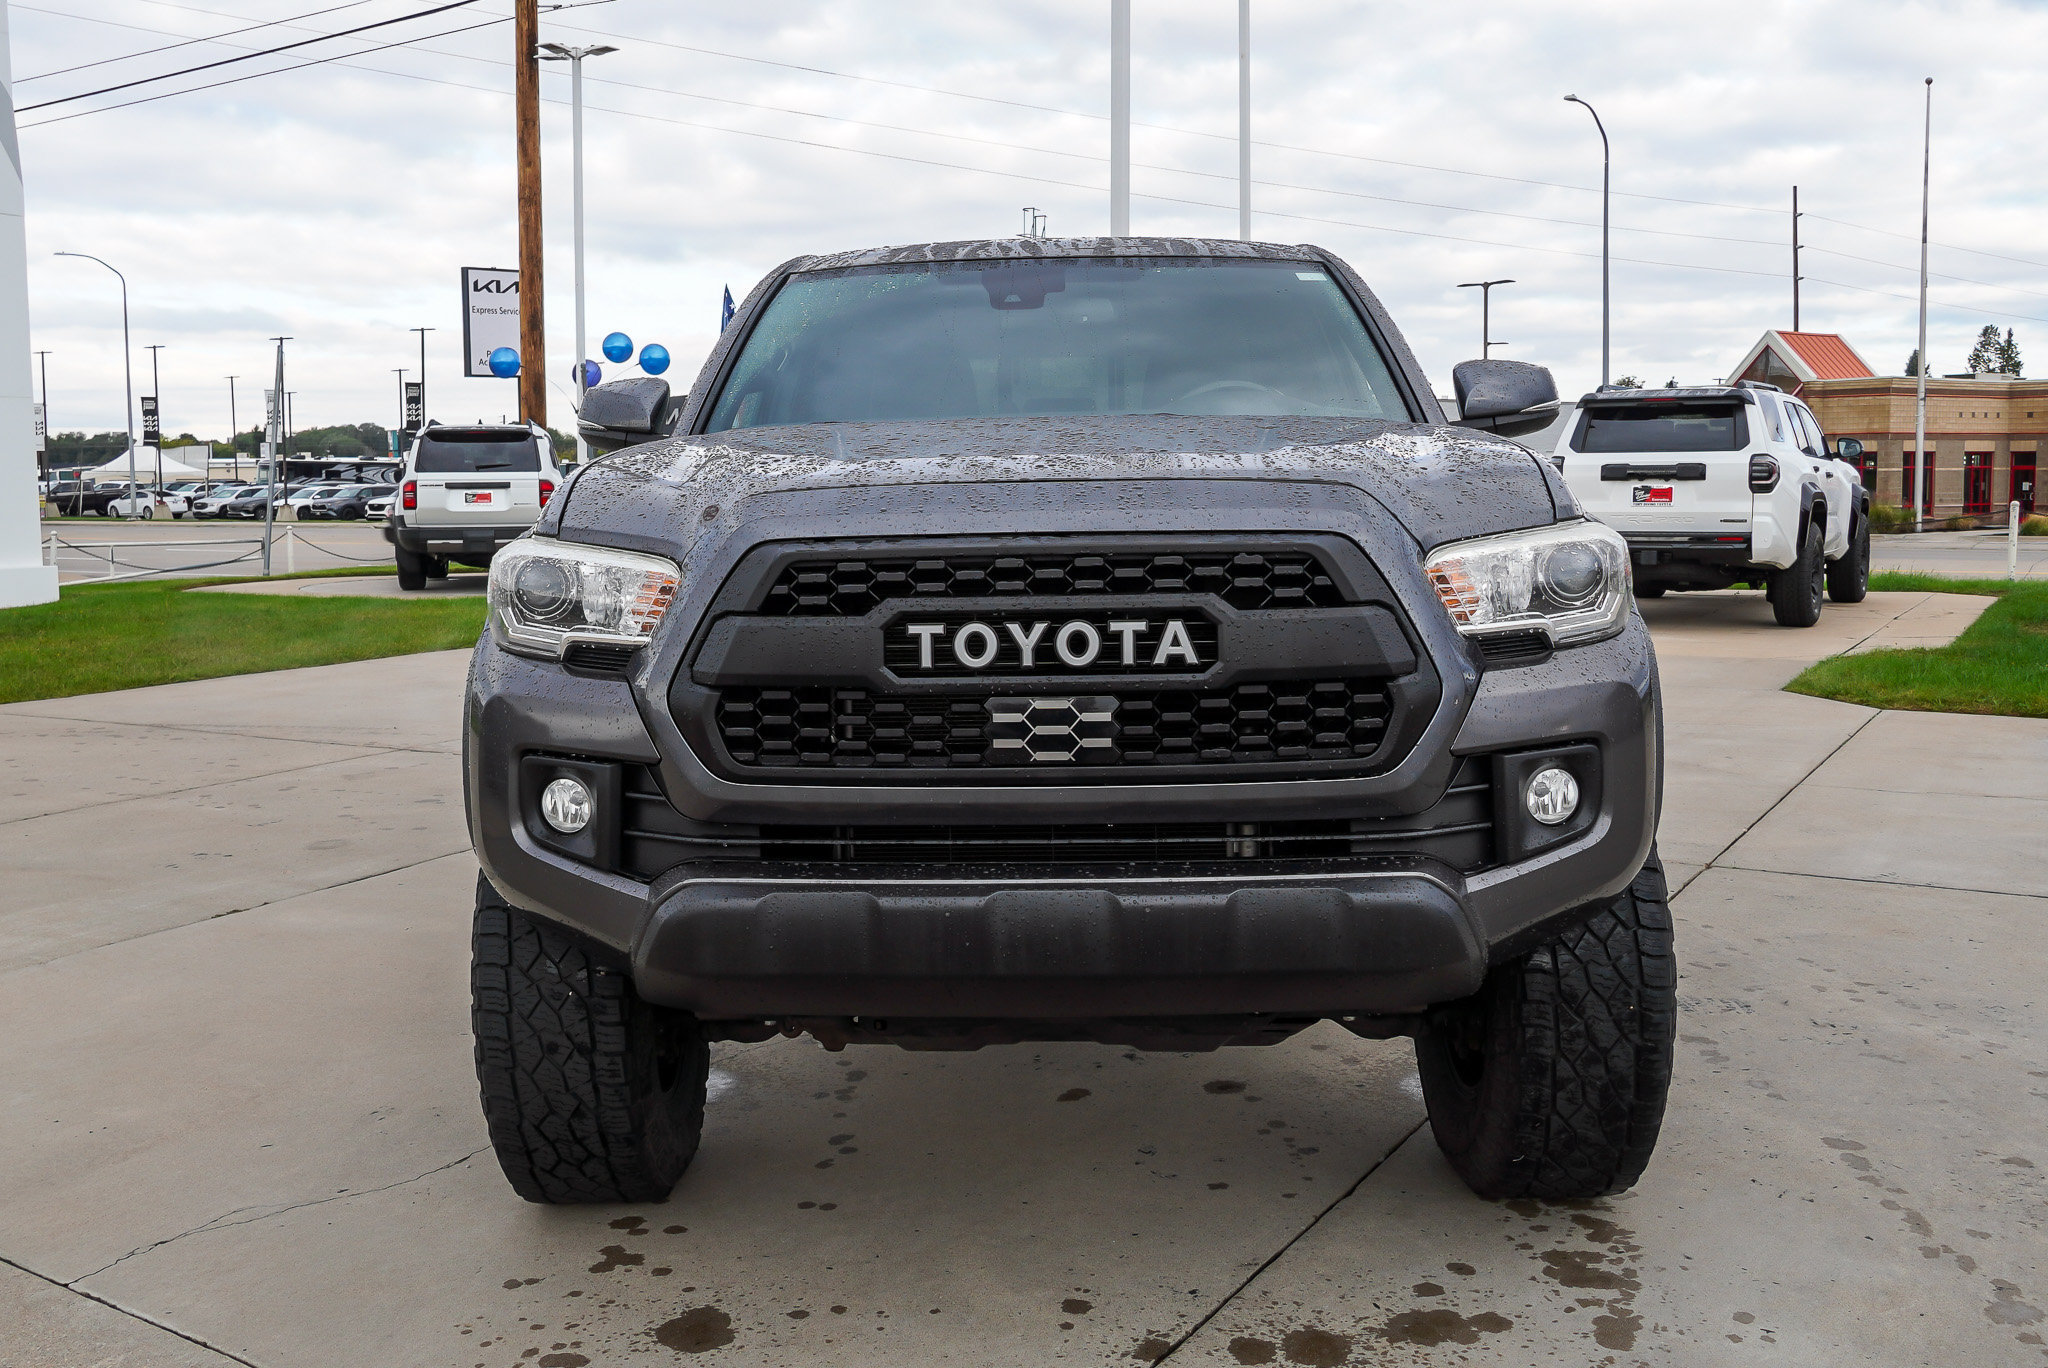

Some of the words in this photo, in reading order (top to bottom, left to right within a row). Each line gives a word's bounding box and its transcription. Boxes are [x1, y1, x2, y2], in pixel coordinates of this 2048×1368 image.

[473, 279, 519, 294] KIA
[472, 306, 498, 315] Express
[499, 307, 520, 316] Servic
[1610, 514, 1654, 526] TRD
[1655, 516, 1695, 524] PRO
[906, 620, 1199, 669] TOYOTA
